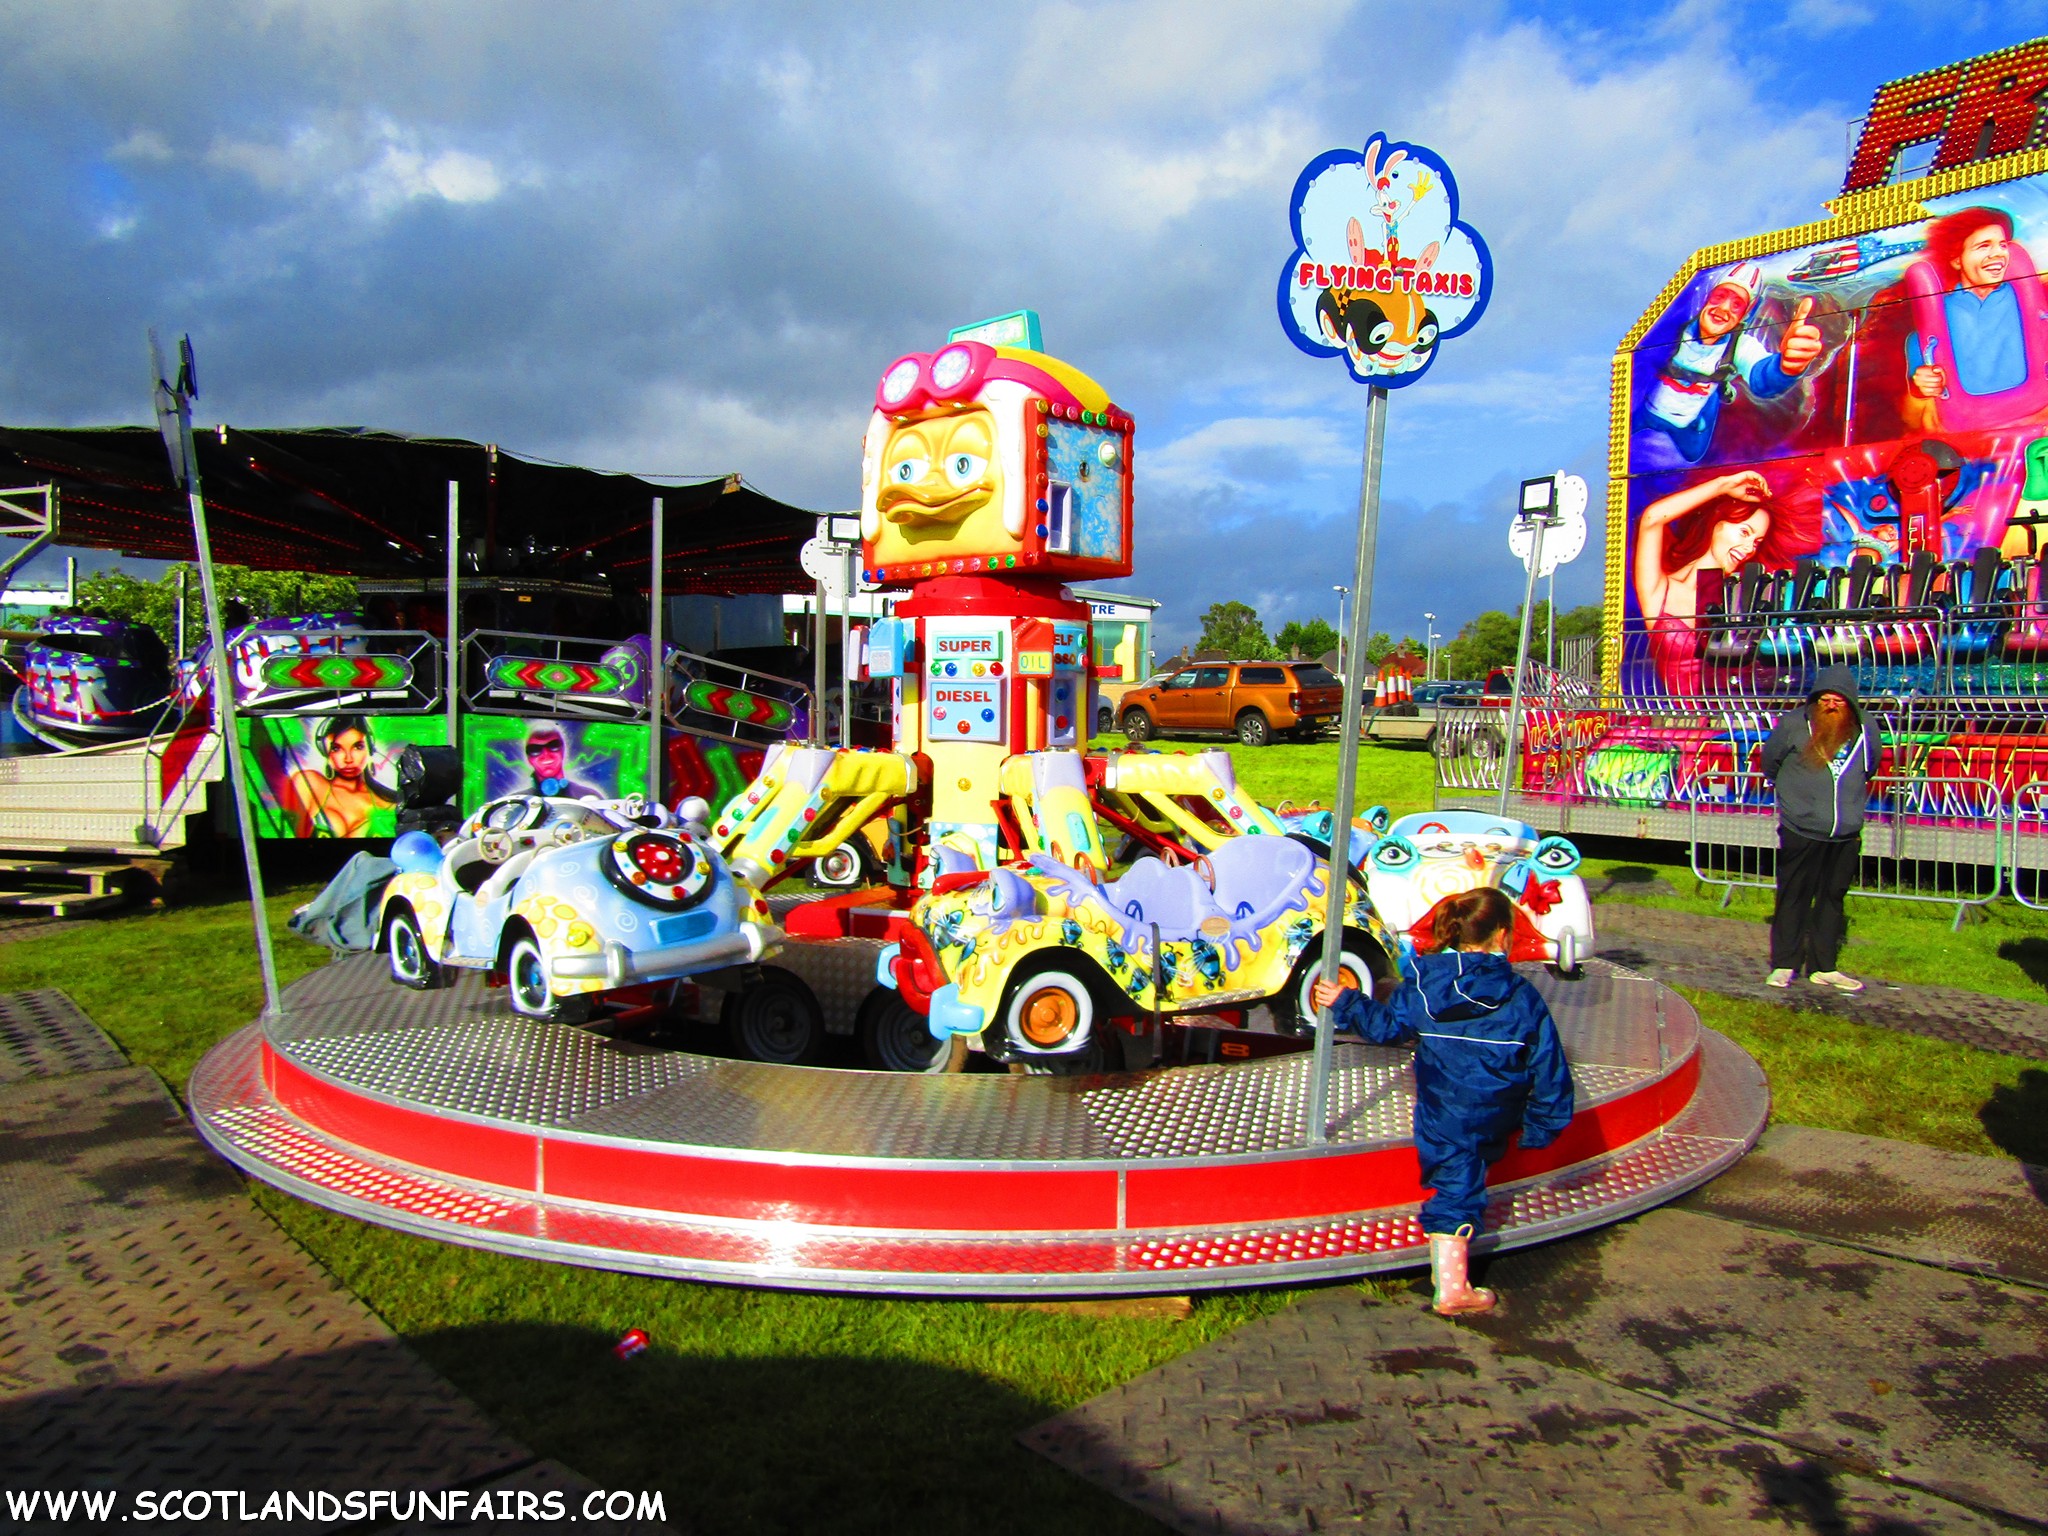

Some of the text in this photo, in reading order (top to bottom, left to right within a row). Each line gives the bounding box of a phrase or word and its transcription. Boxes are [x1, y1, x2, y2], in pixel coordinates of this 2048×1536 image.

[1299, 262, 1474, 297] FLYING TAXIS
[938, 640, 992, 652] SUPER
[1020, 655, 1046, 670] OIL
[936, 690, 992, 702] DIESEL
